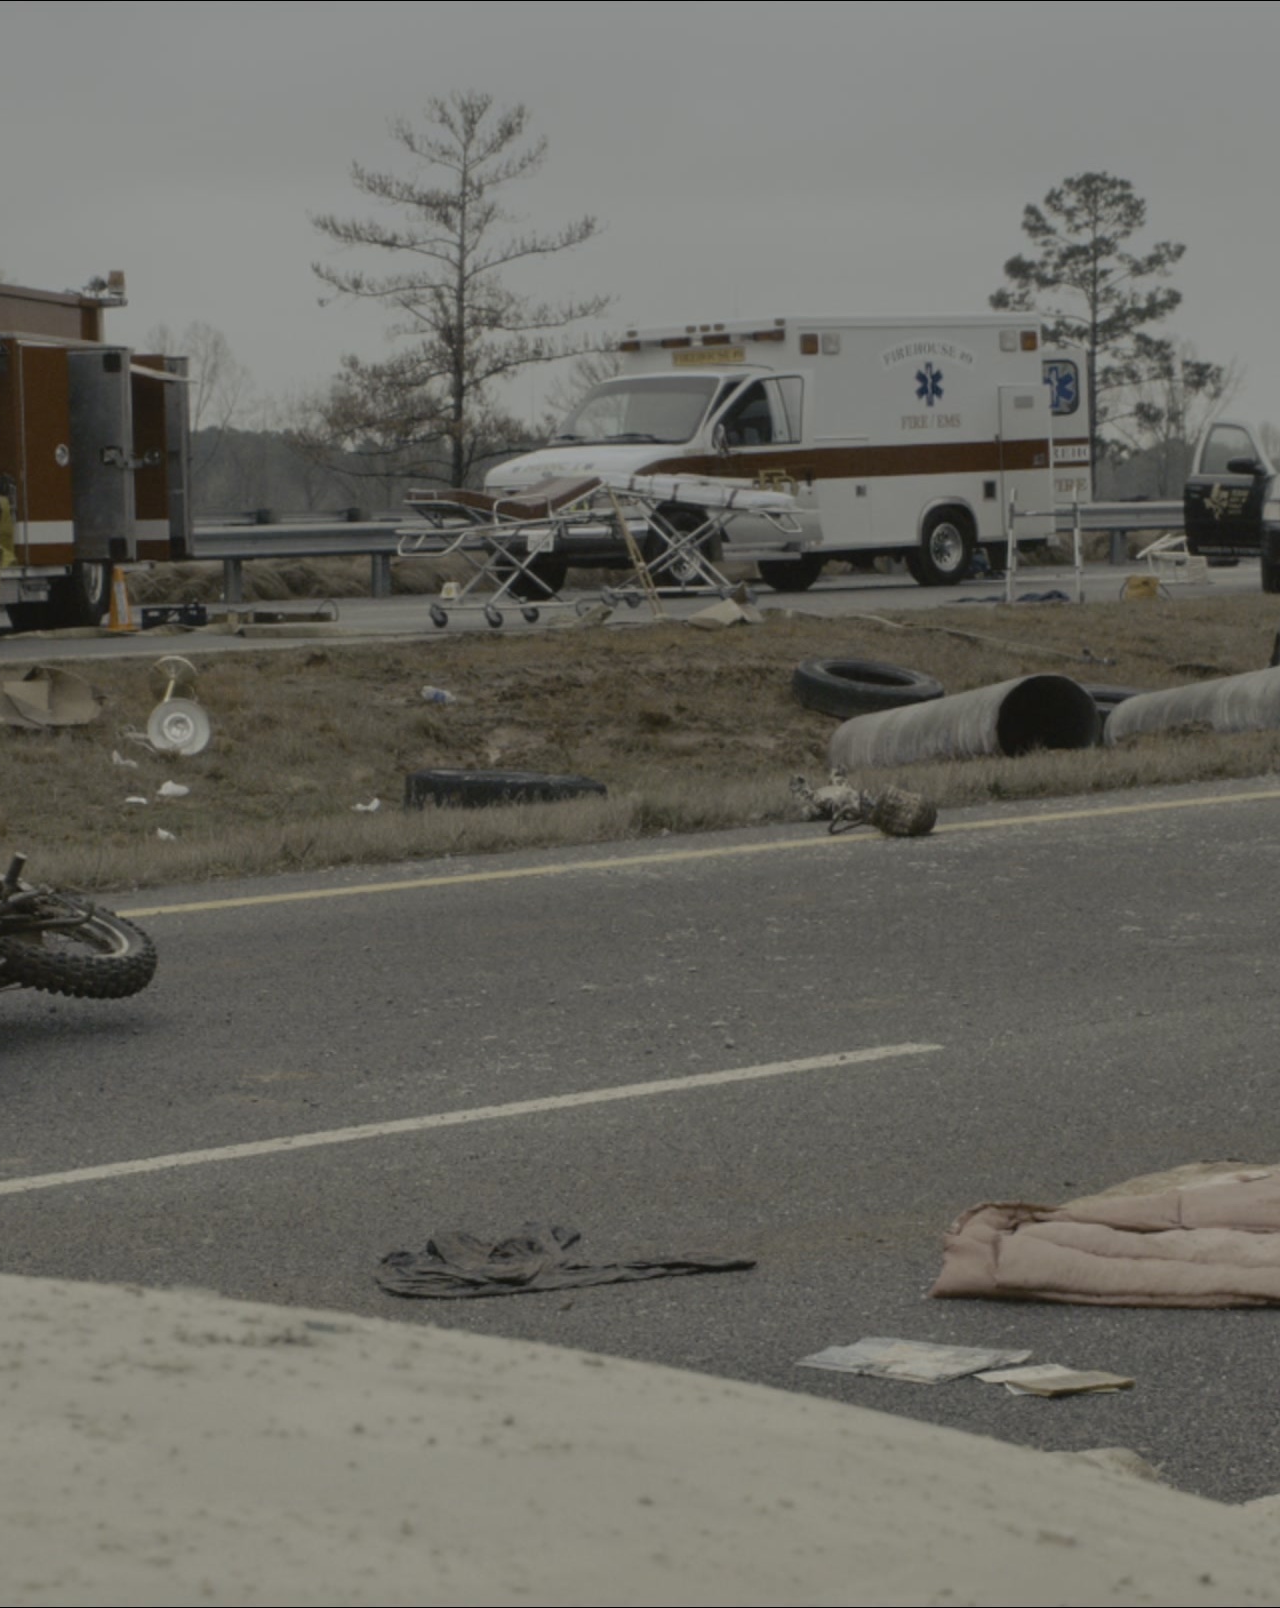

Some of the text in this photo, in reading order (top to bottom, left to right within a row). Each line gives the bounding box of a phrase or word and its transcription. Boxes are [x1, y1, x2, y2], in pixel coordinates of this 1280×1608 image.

[883, 342, 956, 364] FIREHOUSE
[901, 415, 929, 430] FIRE
[937, 413, 961, 429] EMS
